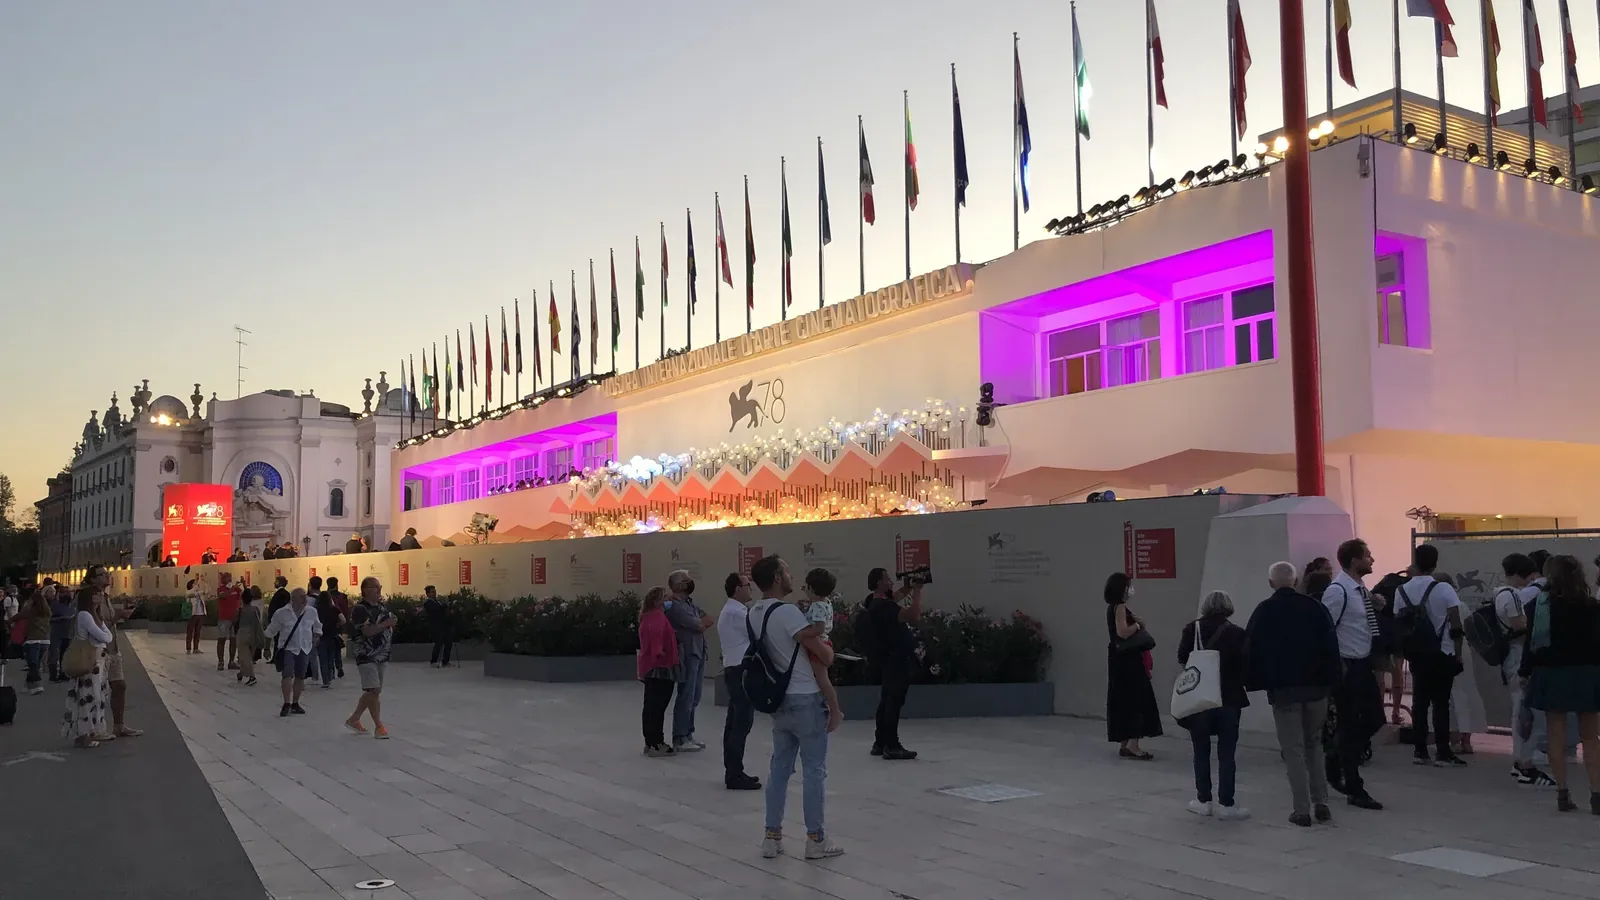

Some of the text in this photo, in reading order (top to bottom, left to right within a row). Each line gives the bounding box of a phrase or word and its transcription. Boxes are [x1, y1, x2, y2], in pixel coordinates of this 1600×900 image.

[602, 264, 962, 396] MOSTRA INTERNAZIONALE D'ARTE CINEMATOGRAFICA
[757, 378, 786, 427] 78
